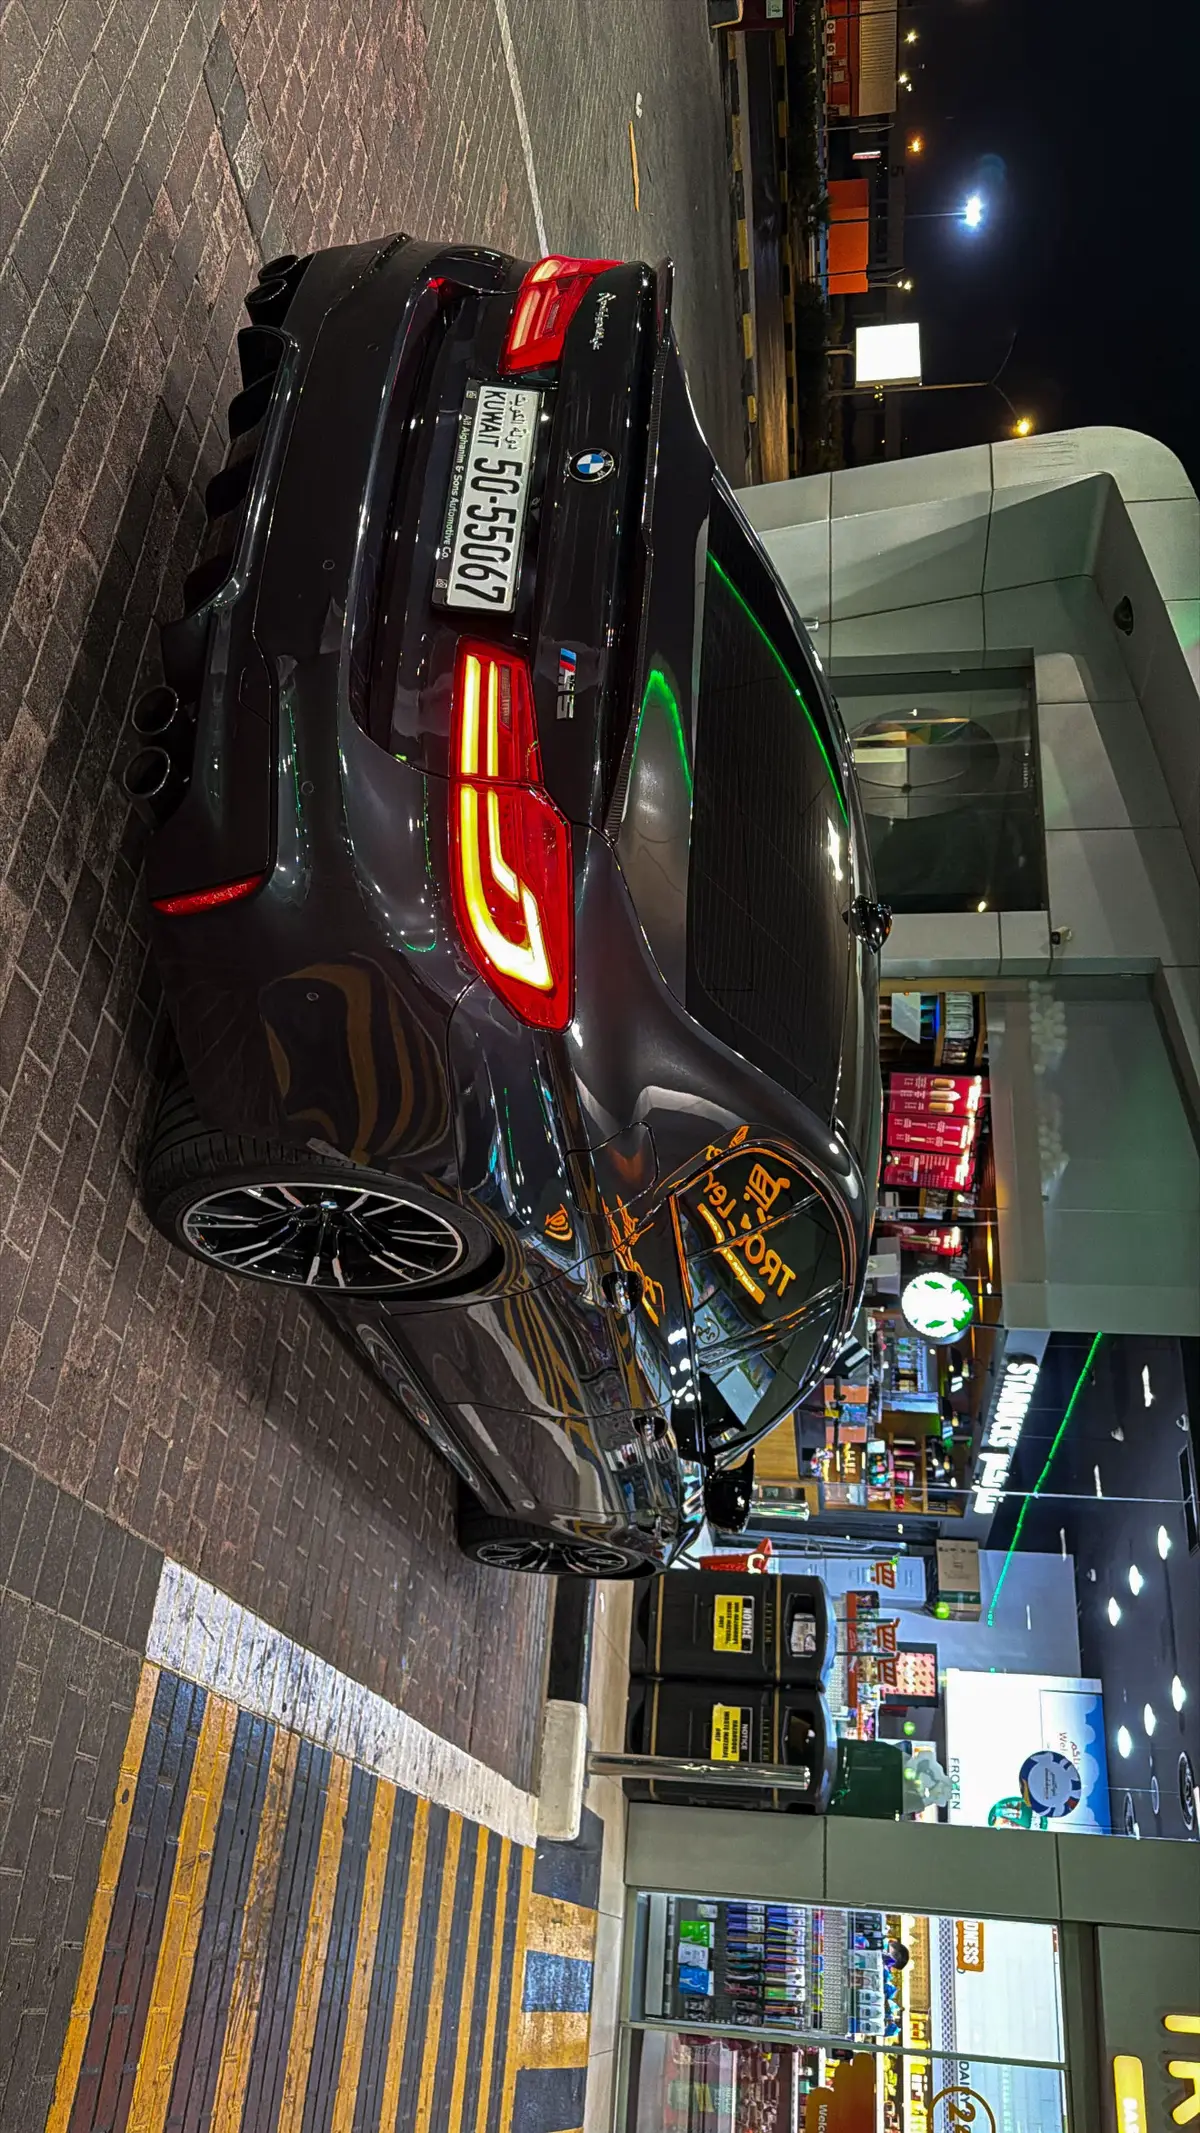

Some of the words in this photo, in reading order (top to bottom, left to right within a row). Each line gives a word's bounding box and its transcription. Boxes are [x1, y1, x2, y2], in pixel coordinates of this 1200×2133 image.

[462, 414, 472, 426] Ali
[477, 390, 507, 448] KUWAIT
[508, 394, 529, 426] الكويت
[456, 426, 471, 464] Alghanim
[504, 426, 528, 451] دولة
[450, 474, 462, 496] Sons
[455, 465, 464, 473] &
[442, 497, 458, 546] Automotive
[454, 457, 524, 604] 50-55067
[440, 546, 452, 560] Co.
[556, 668, 576, 720] M5
[988, 1362, 1040, 1448] STARBUCKS
[971, 1452, 1010, 1514] ستاربكس
[742, 1608, 752, 1640] NOTICE
[818, 2104, 828, 2133] Welc
